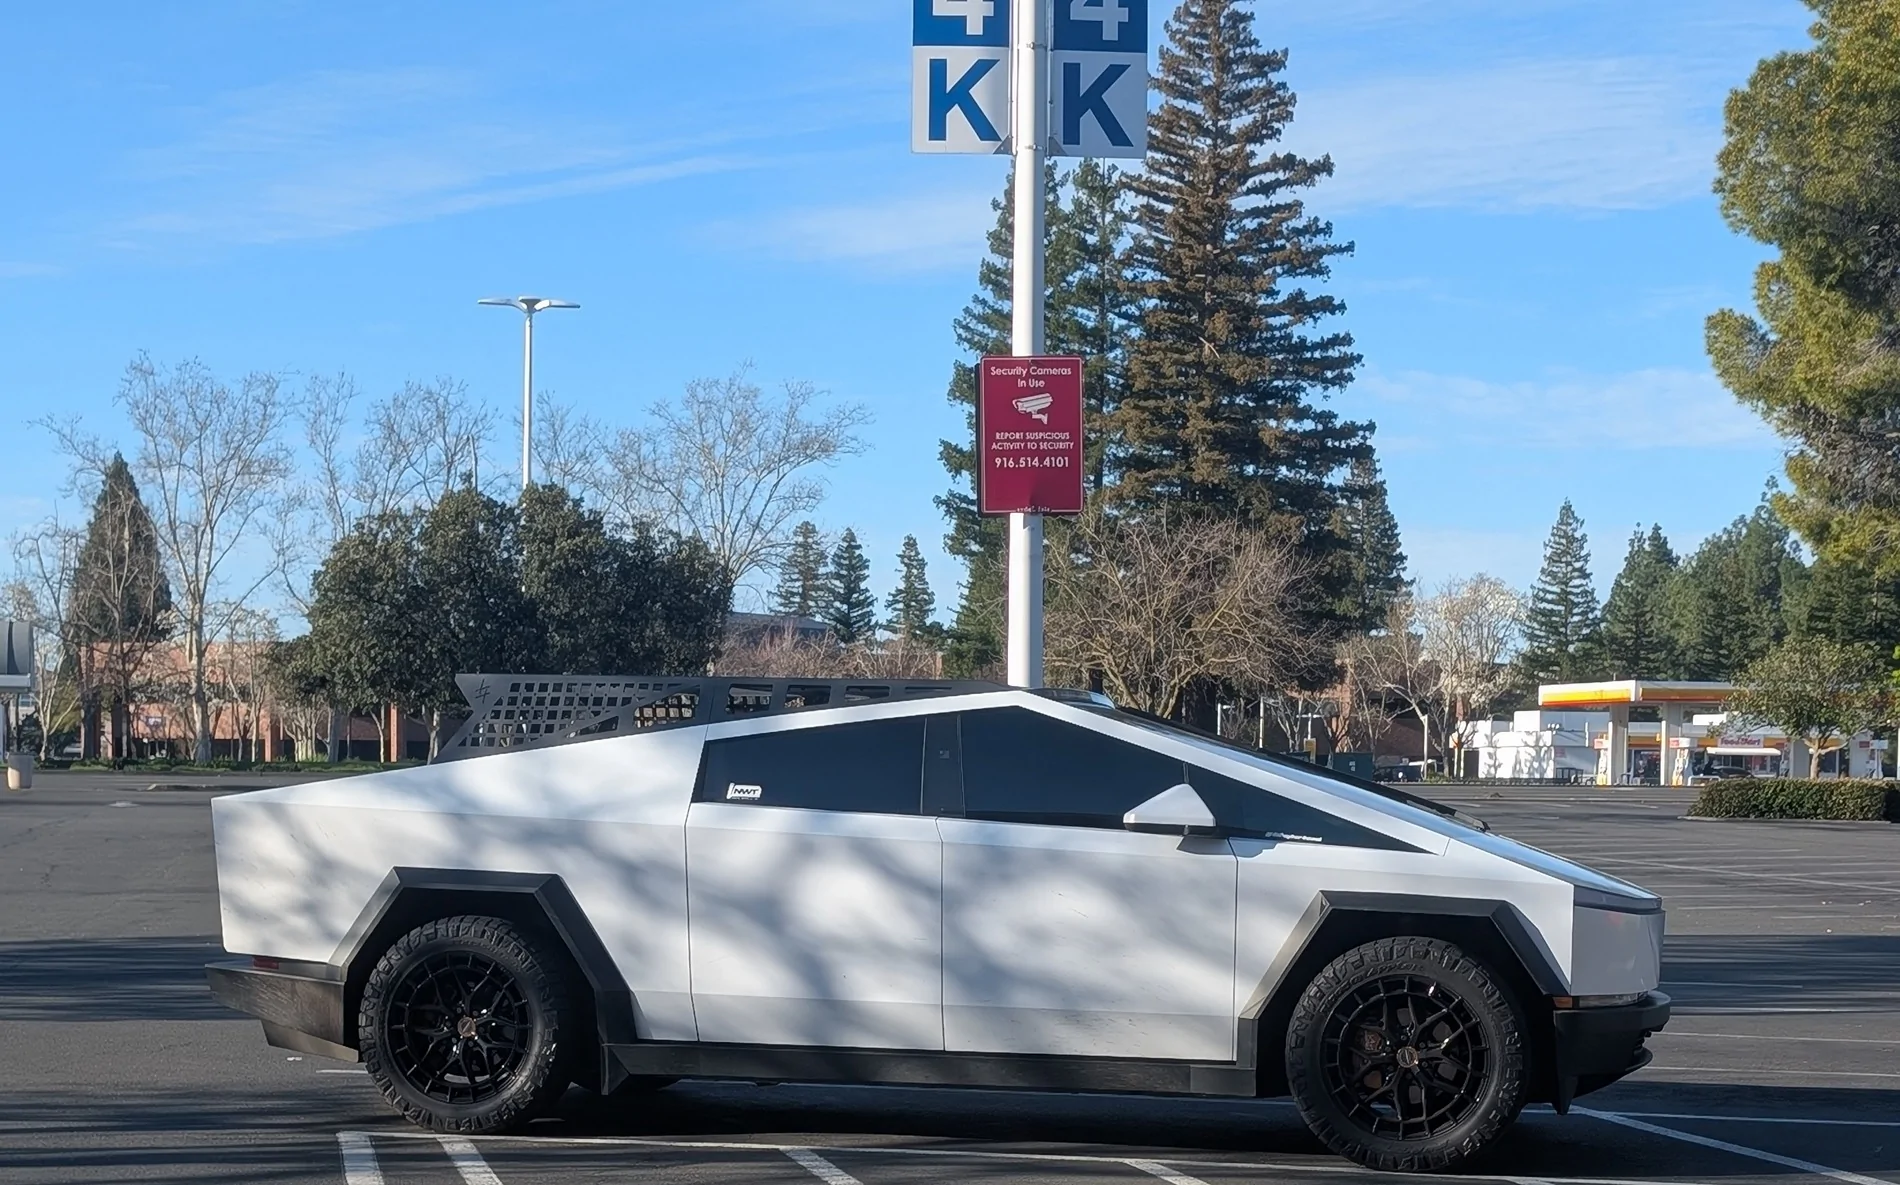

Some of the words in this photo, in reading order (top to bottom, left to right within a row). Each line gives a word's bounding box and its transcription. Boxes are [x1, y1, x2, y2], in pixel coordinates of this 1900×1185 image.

[928, 58, 1002, 142] K
[1062, 62, 1134, 147] K
[990, 366, 1028, 377] Security
[1029, 366, 1072, 376] Cameras
[1017, 378, 1027, 388] In
[1028, 378, 1046, 388] Use
[995, 432, 1024, 440] REPORT
[1025, 432, 1070, 440] SUSPICIOUS
[991, 442, 1025, 450] ACTIVITY
[1026, 442, 1038, 450] TO
[1039, 442, 1074, 450] SECURITY
[994, 456, 1069, 468] 916.514.4101
